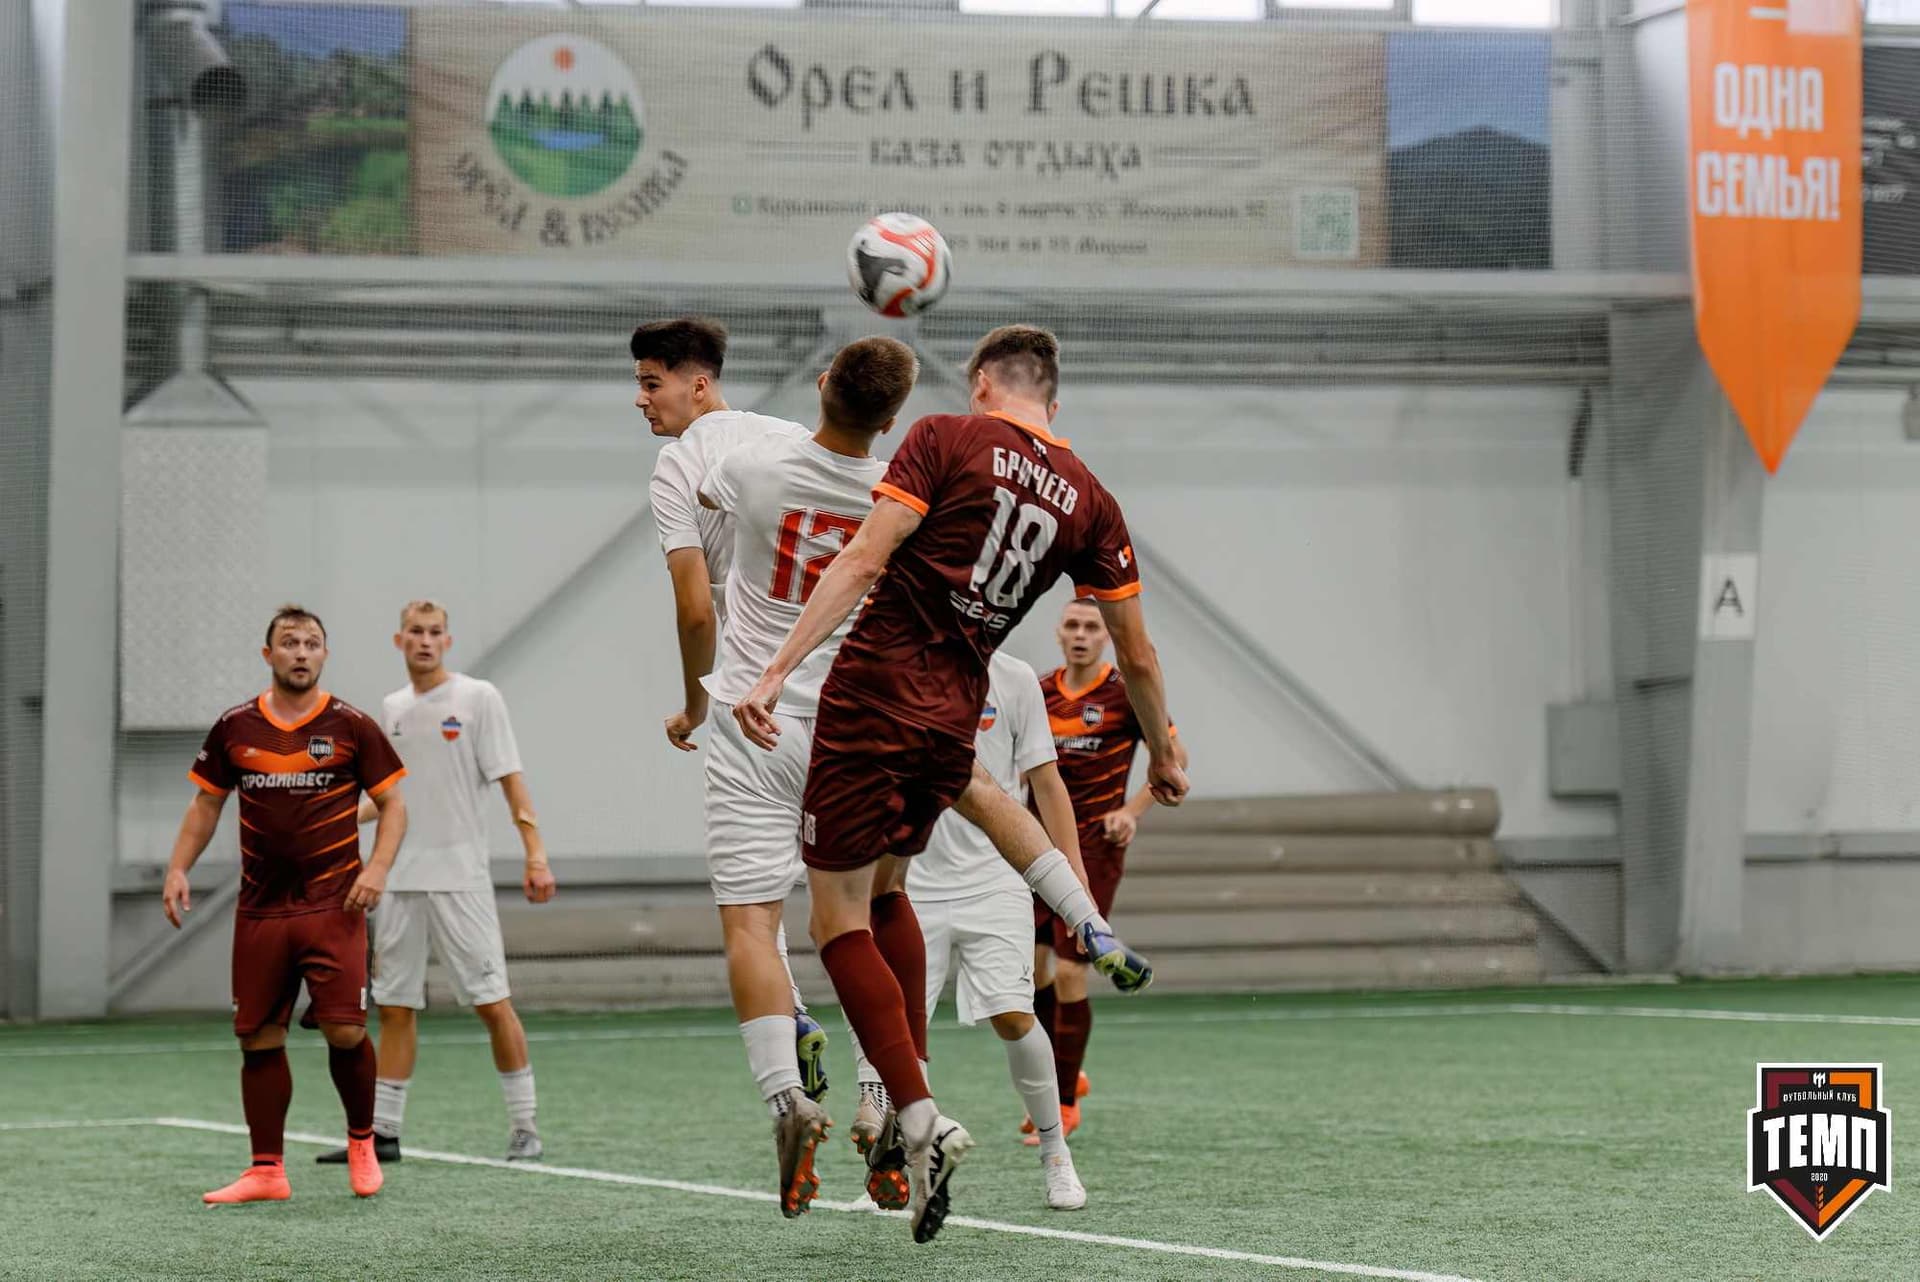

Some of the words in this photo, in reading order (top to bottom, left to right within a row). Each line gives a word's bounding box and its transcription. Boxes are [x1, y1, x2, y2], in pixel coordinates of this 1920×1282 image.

[1713, 62, 1823, 140] ОДНА
[1696, 151, 1841, 221] СЕМЬЯ!
[969, 486, 1059, 609] 18
[1713, 577, 1745, 618] А
[241, 772, 335, 790] ПРОДИНВЕСТ
